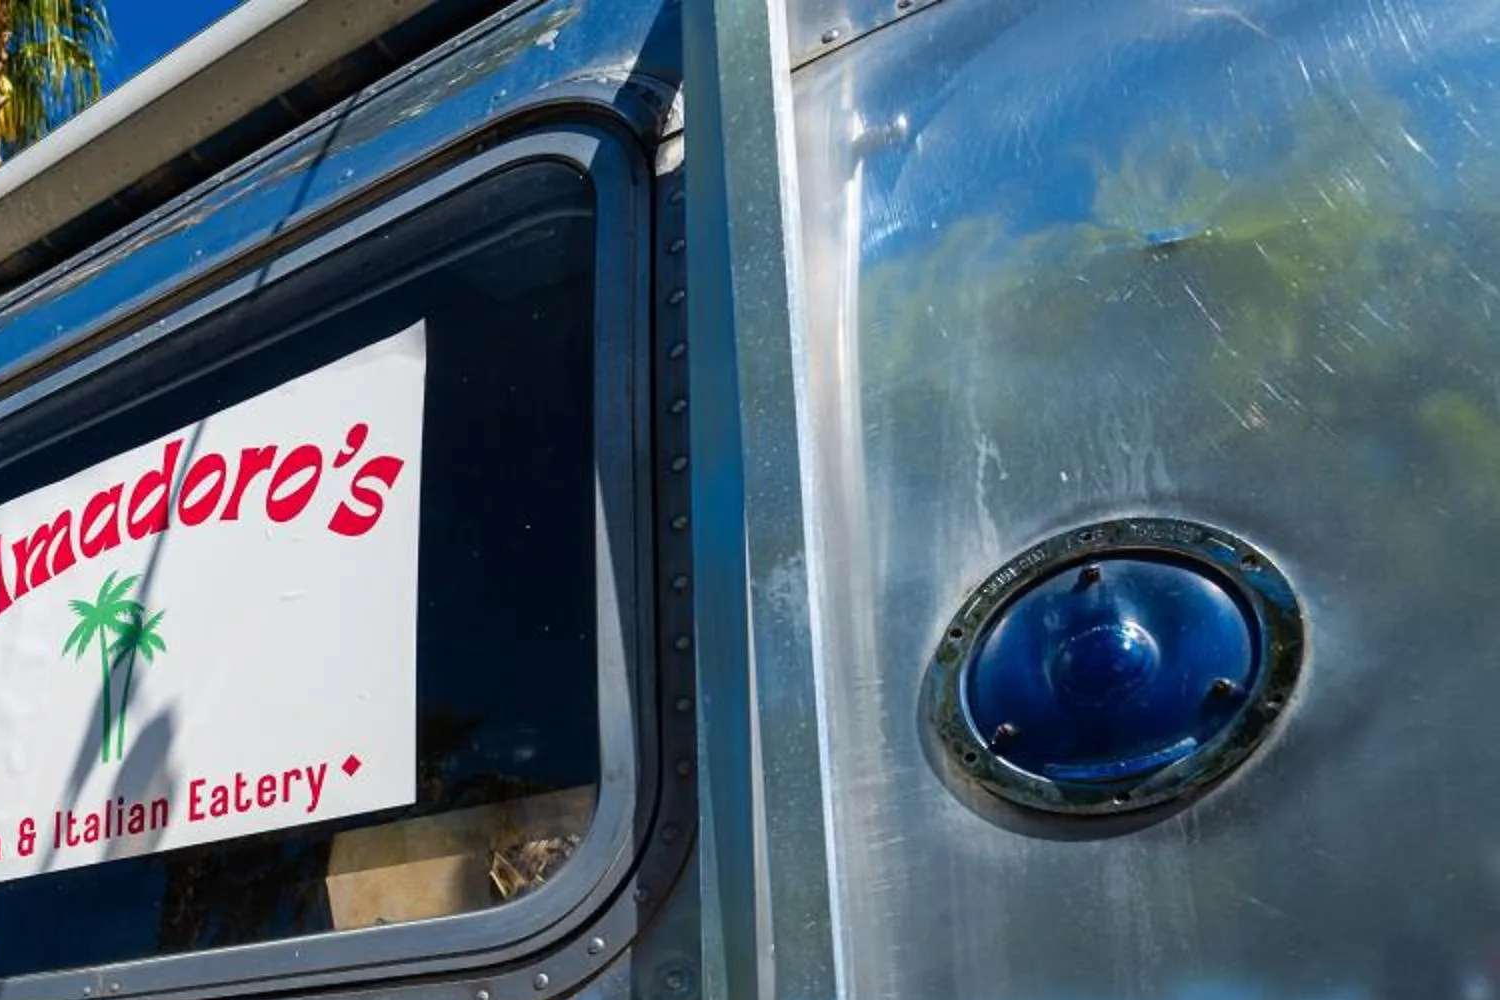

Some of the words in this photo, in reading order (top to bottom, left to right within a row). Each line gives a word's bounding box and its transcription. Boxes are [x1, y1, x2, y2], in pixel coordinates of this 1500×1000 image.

[16, 816, 37, 857] &
[53, 798, 169, 849] Italian
[187, 763, 329, 823] Eatery
